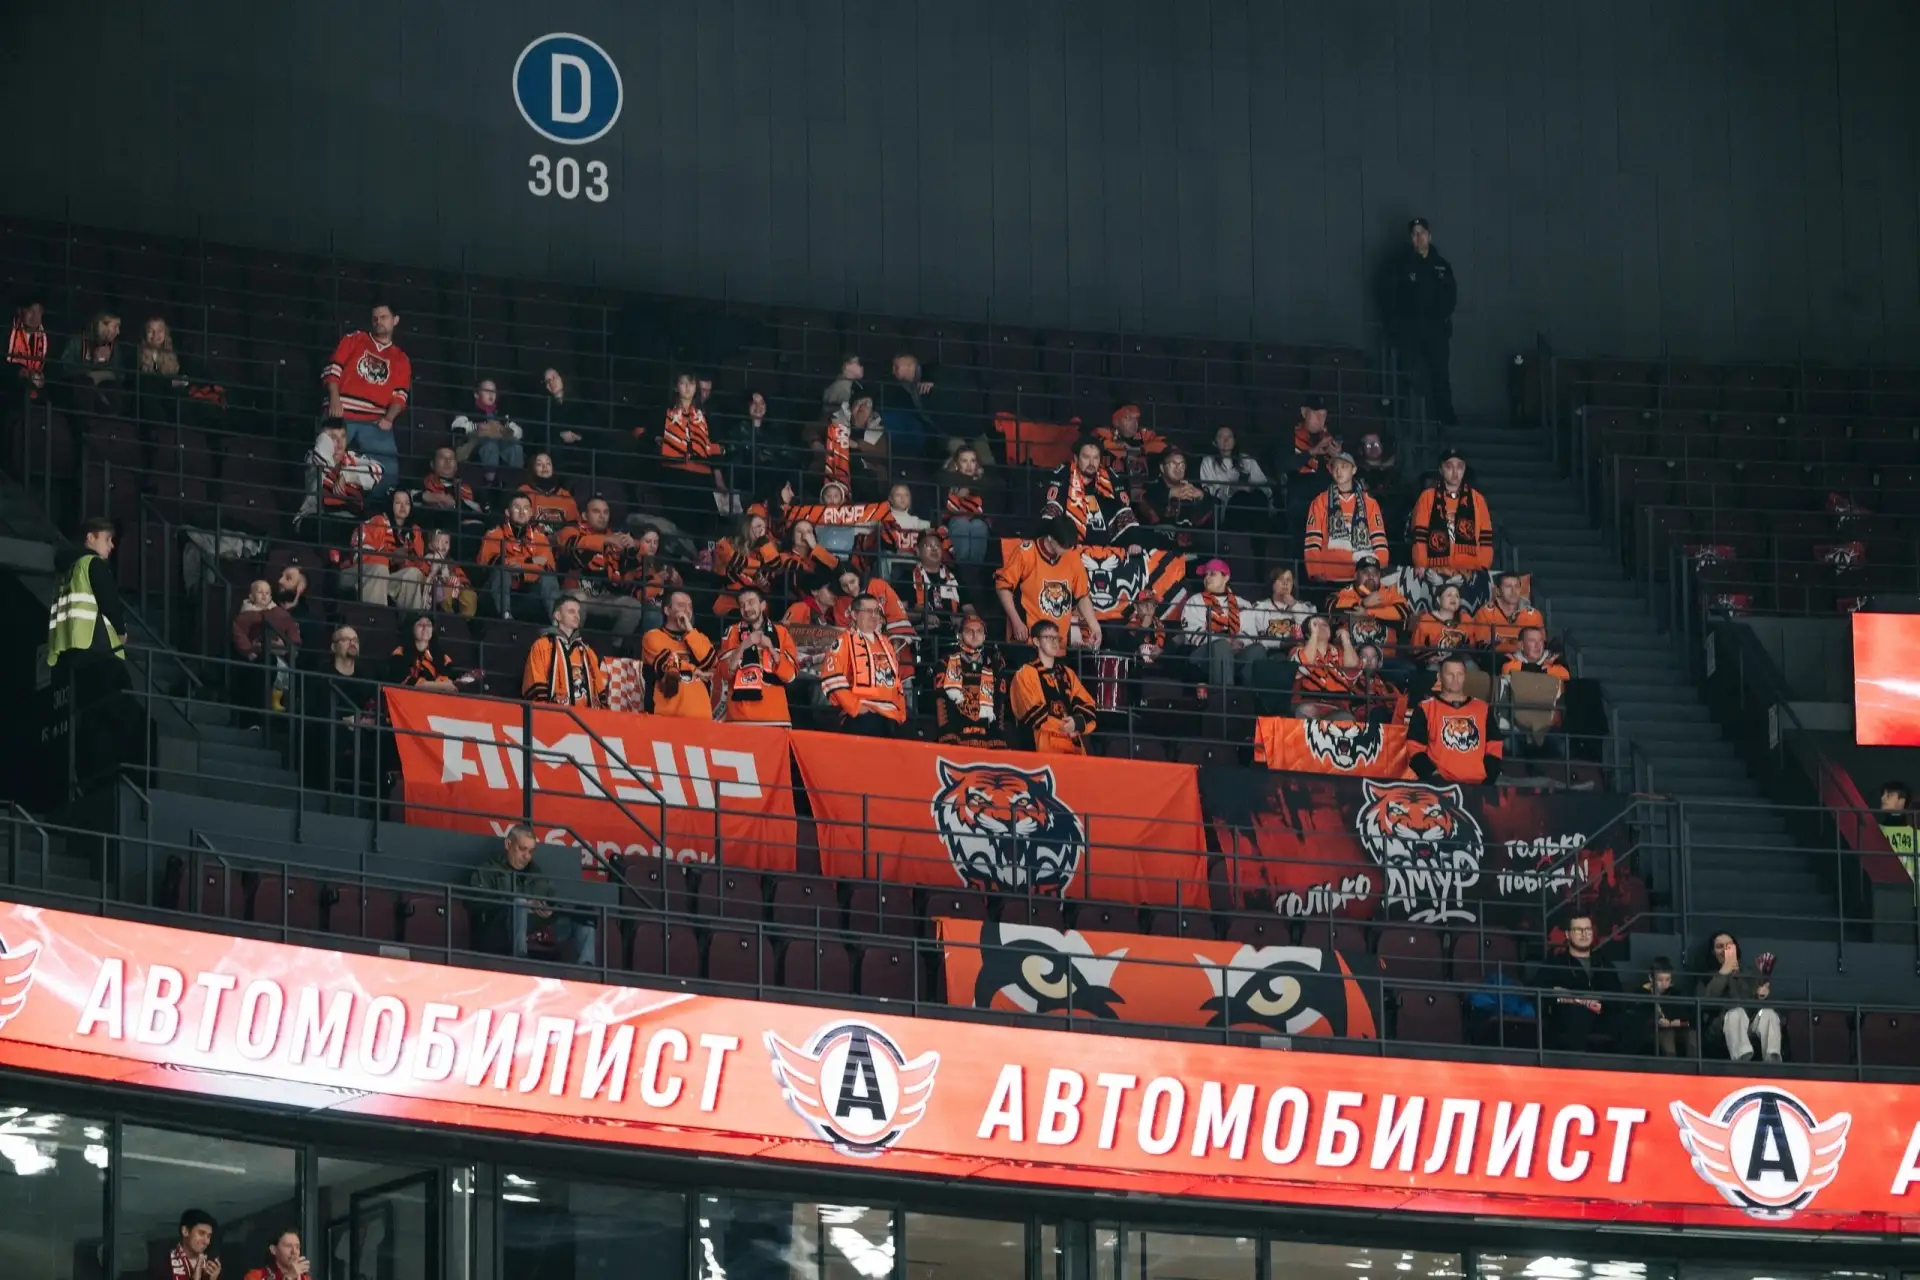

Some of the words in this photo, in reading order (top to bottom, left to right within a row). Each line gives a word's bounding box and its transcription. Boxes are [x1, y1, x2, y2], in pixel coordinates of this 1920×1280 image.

[551, 53, 592, 124] D
[528, 154, 609, 203] 303
[824, 505, 866, 524] АМУР
[427, 715, 763, 808] АМУР
[1382, 849, 1481, 923] АМУР
[76, 957, 740, 1112] АВТОМОБИЛИСТ
[976, 1063, 1647, 1183] АВТОМОБИЛИСТ
